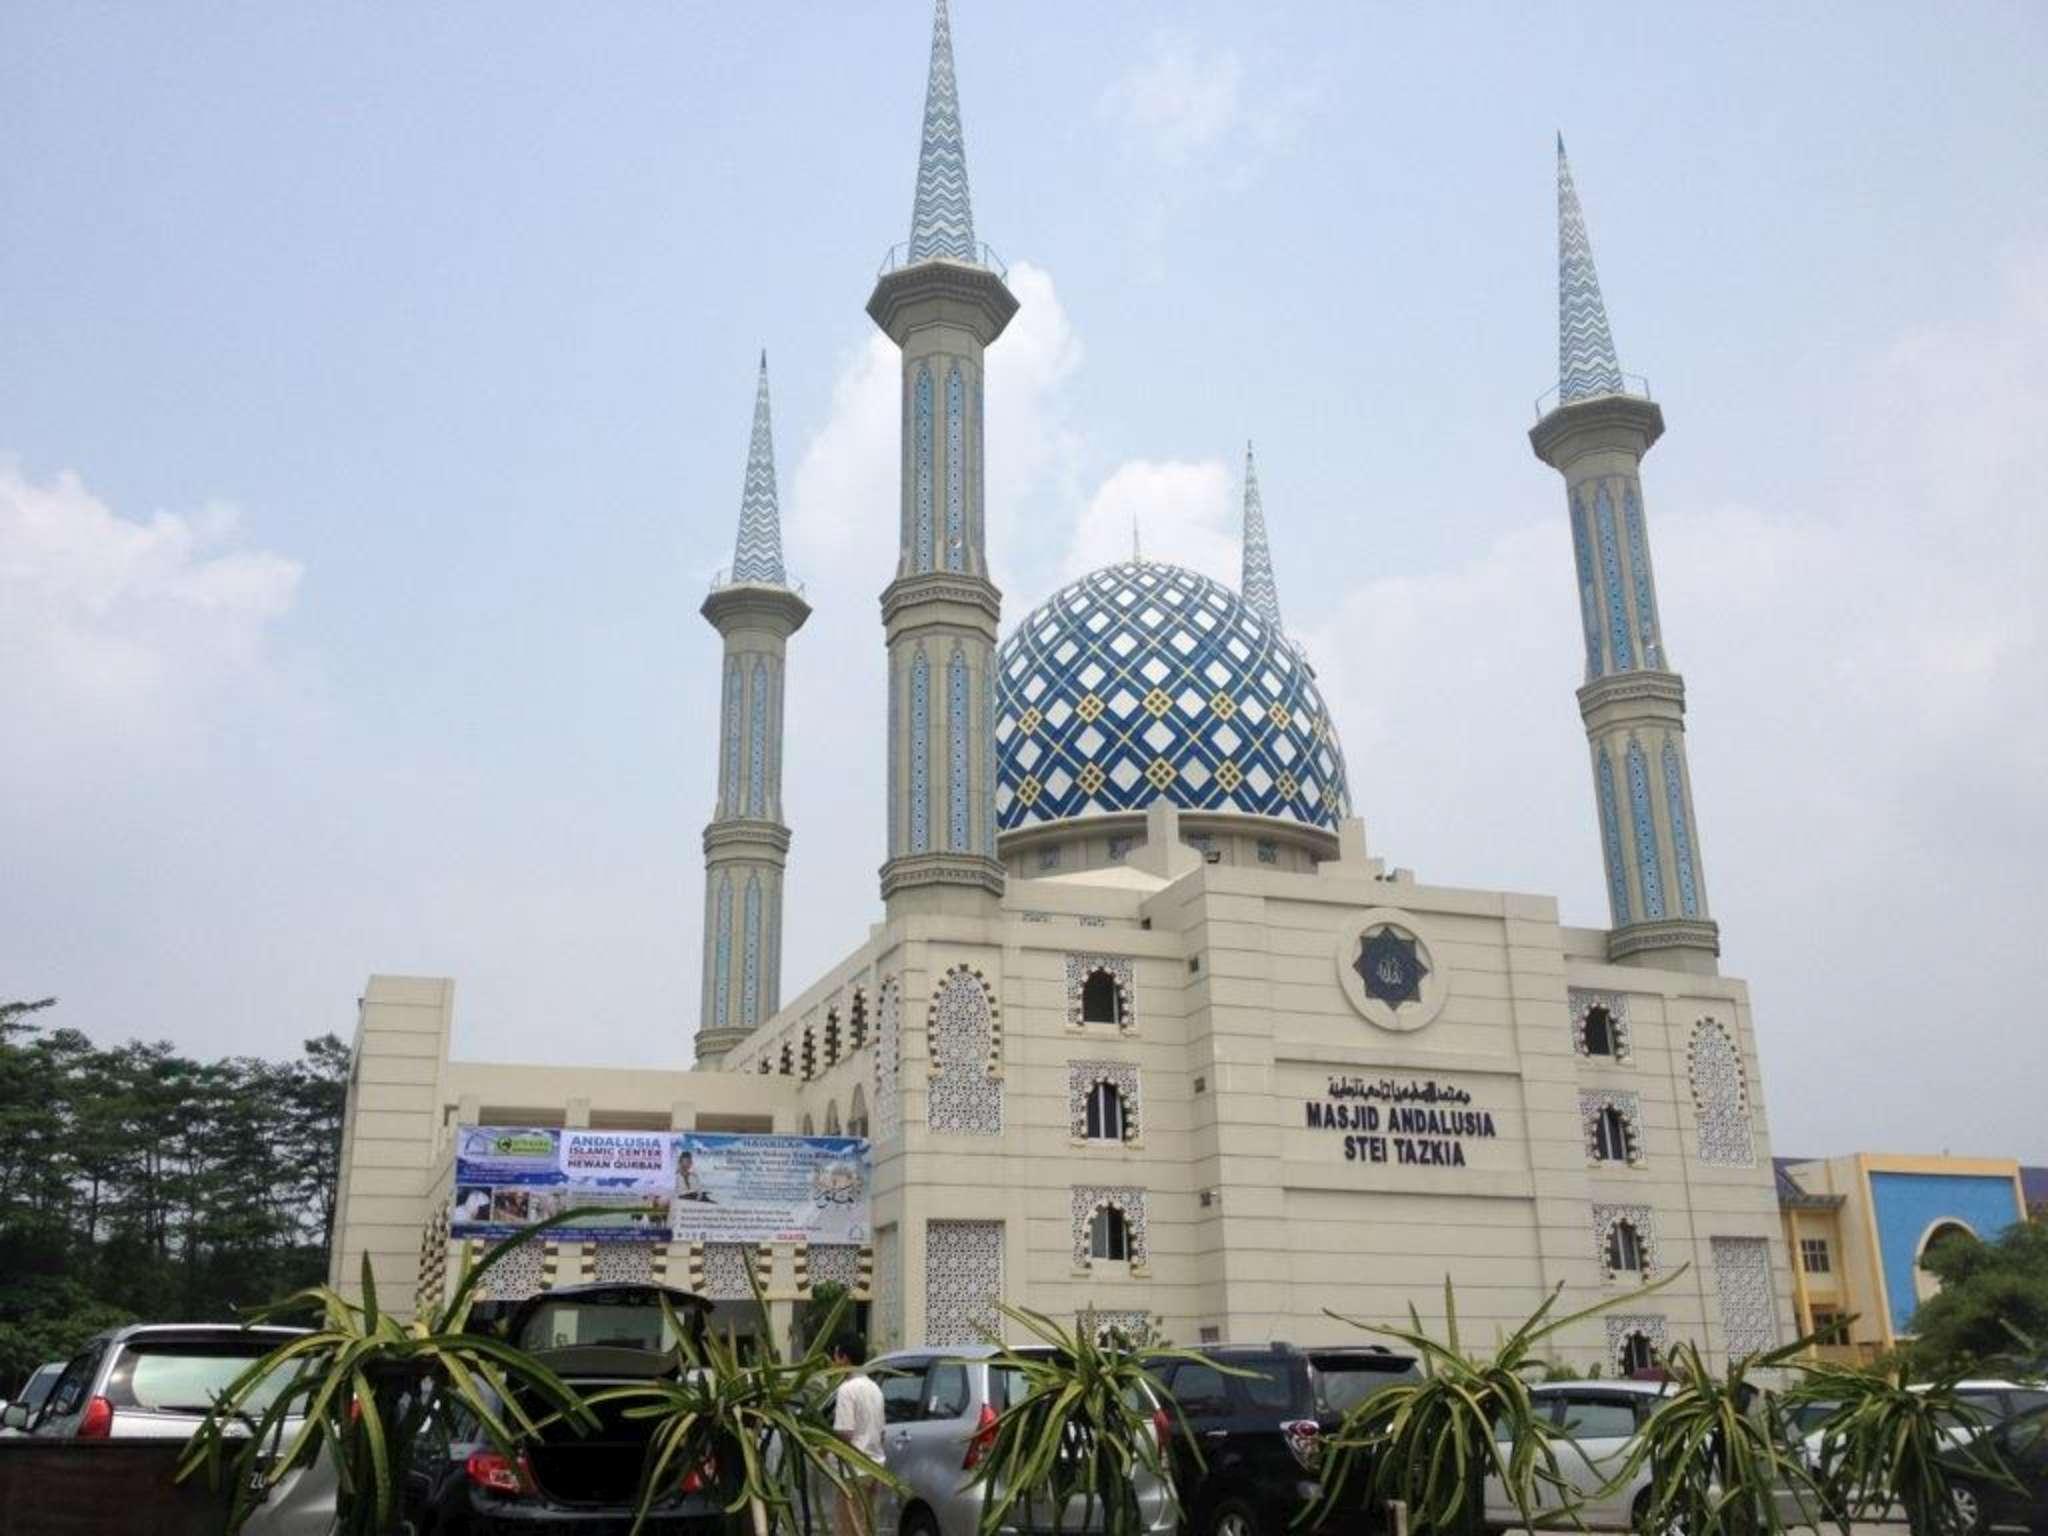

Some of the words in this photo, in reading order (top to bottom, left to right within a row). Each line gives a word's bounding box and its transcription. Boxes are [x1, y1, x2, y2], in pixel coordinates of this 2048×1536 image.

[1306, 1101, 1379, 1131] MASJID
[1388, 1107, 1496, 1137] ANDALUSIA
[571, 1135, 661, 1149] ANDALUSIA
[569, 1146, 614, 1156] ISLAMIC
[617, 1147, 662, 1157] CENTER
[1344, 1135, 1387, 1163] STEI
[1393, 1138, 1466, 1167] TAZKIA
[567, 1160, 611, 1169] HEWAN
[613, 1160, 662, 1170] QURBAN
